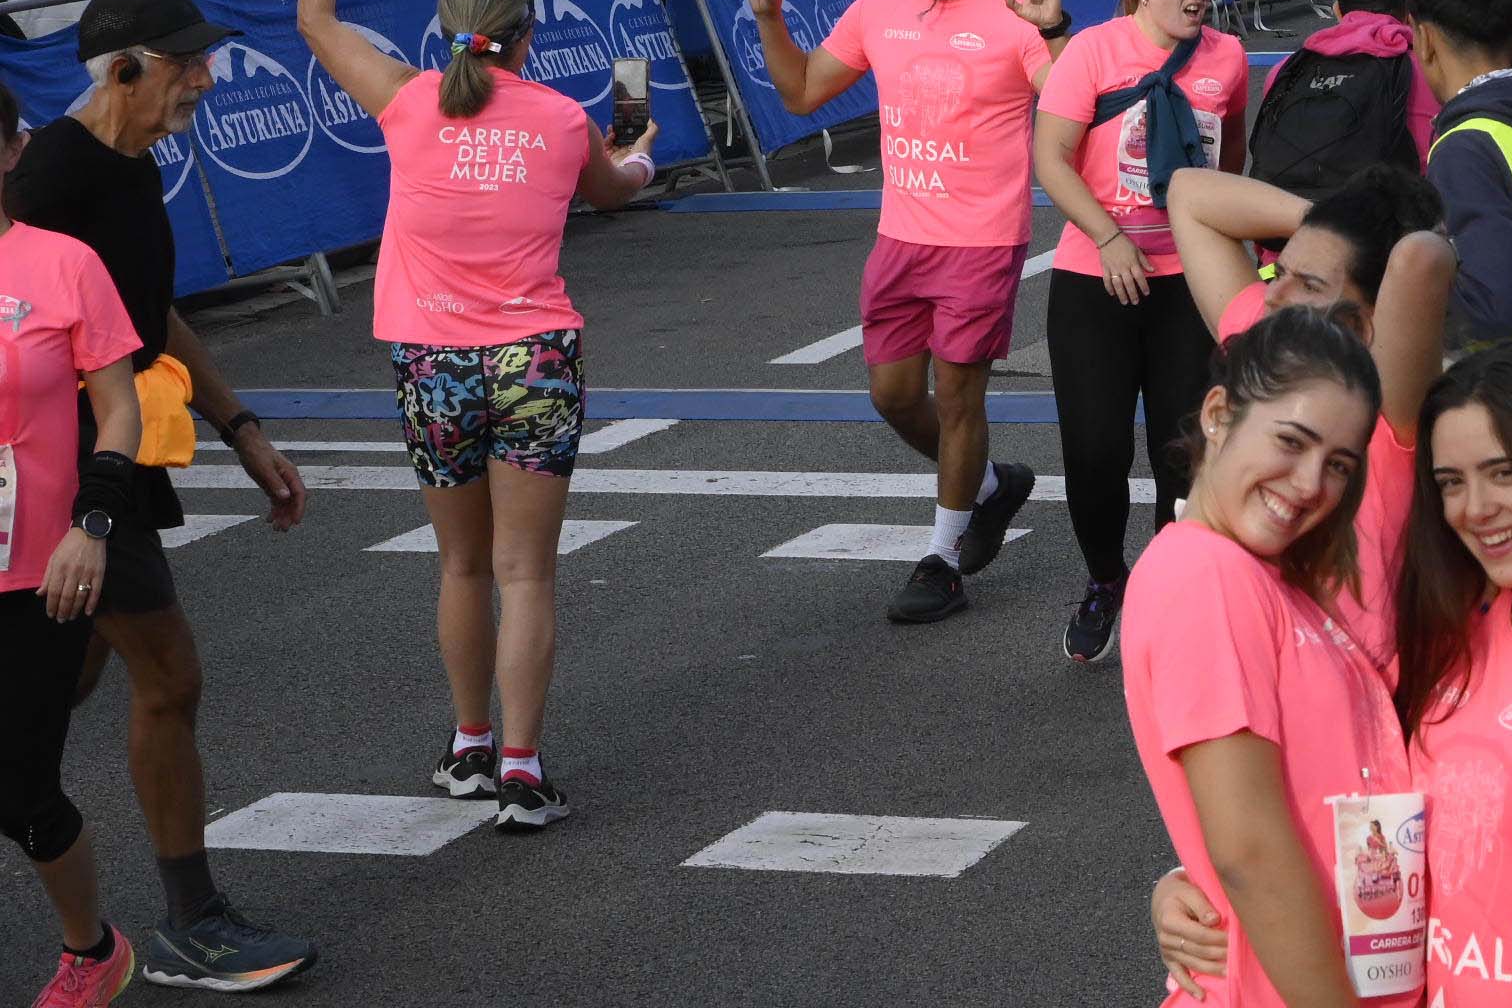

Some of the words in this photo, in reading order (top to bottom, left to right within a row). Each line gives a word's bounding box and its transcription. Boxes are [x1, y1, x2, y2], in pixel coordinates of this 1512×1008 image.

[884, 28, 921, 41] OYSHO
[529, 42, 611, 82] ASTURIANA
[1310, 73, 1346, 89] CAT
[215, 89, 255, 107] CENTRAL
[204, 99, 308, 152] ASTURIANA
[884, 104, 901, 128] TU
[438, 125, 547, 151] CARRERA
[457, 145, 488, 163] DE
[497, 146, 525, 165] LA
[886, 135, 970, 162] DORSAL
[450, 162, 528, 184] MUJER
[889, 164, 945, 191] SUMA
[1126, 166, 1148, 175] CARRE
[479, 183, 499, 191] 2023
[1370, 935, 1412, 951] CARRERA
[1367, 962, 1412, 981] OYSHO
